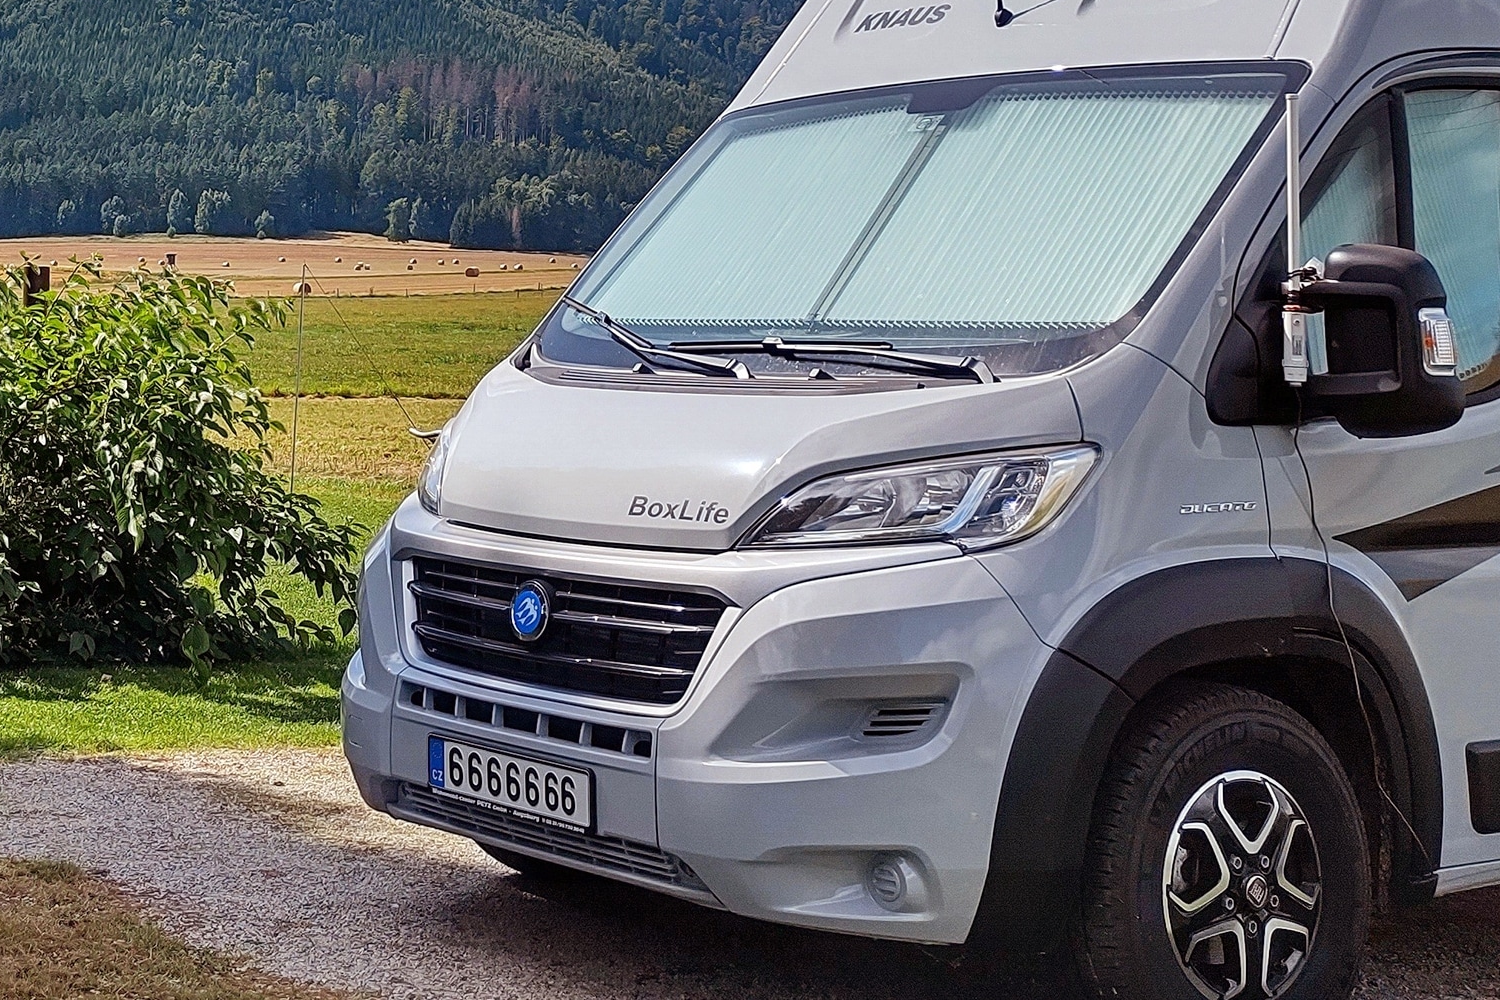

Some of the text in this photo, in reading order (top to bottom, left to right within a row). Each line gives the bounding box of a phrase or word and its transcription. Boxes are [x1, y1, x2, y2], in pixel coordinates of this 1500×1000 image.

[854, 3, 952, 34] KNAUS
[628, 495, 730, 524] BoxLife
[1179, 501, 1257, 515] DUCATO
[432, 768, 444, 782] CZ
[448, 746, 577, 816] 6666666
